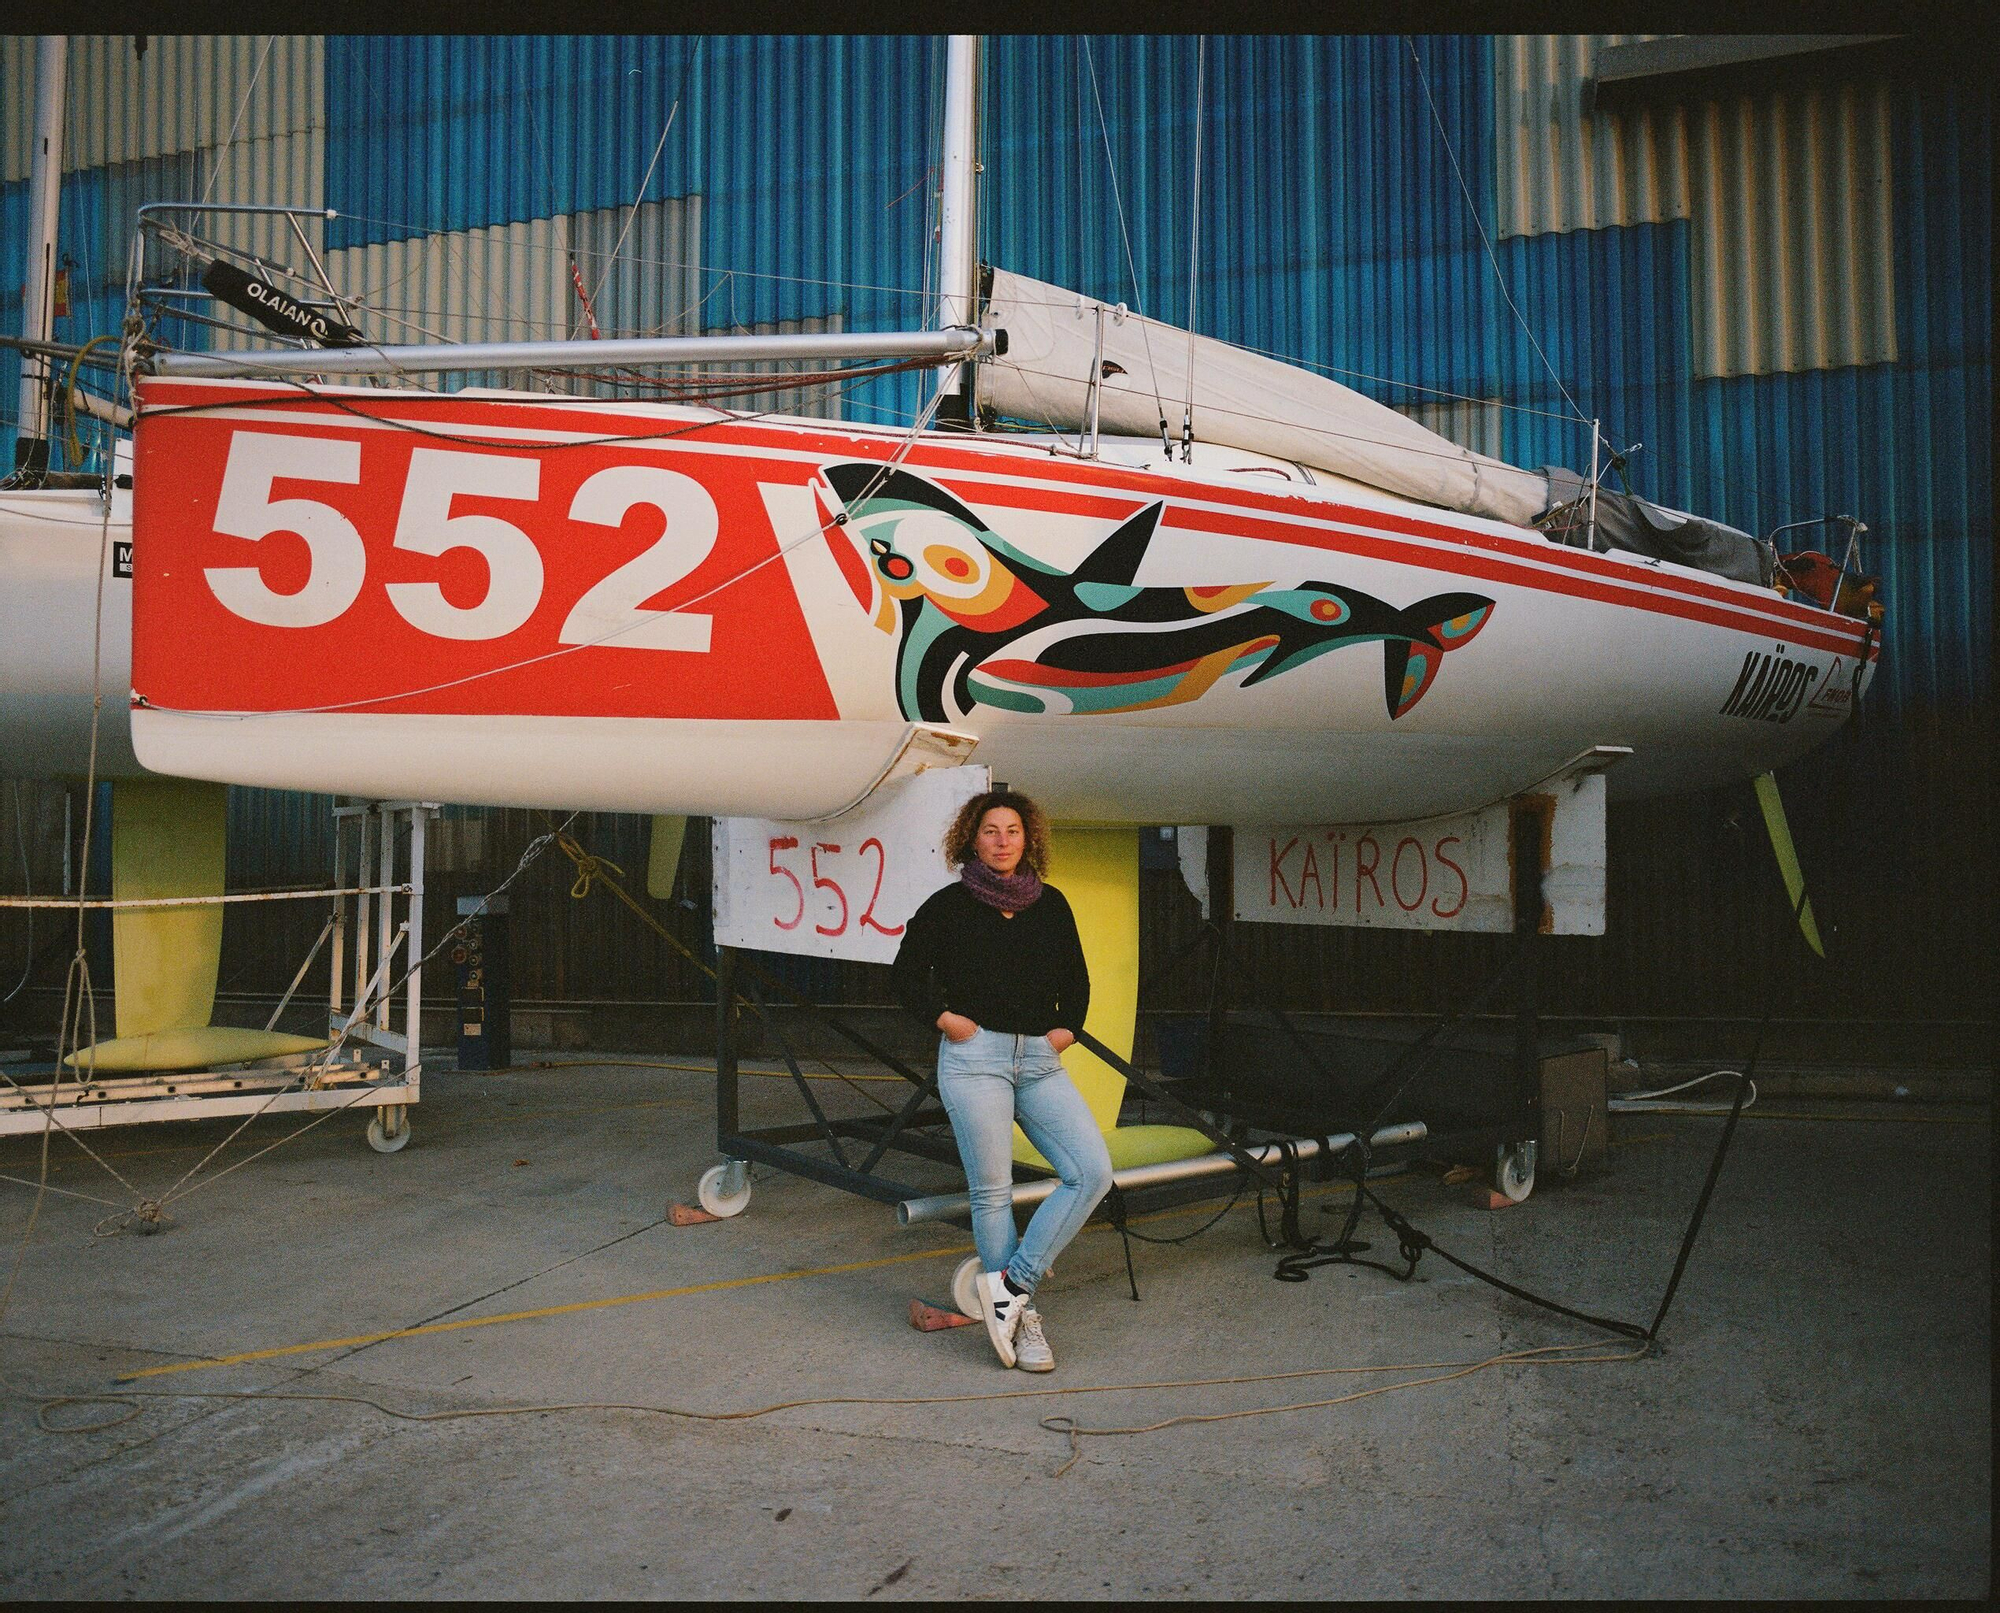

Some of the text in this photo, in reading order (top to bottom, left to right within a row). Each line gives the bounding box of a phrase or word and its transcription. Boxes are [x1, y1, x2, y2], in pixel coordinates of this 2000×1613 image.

[203, 430, 719, 653] 552
[1719, 643, 1819, 724] KAÏROS
[770, 837, 905, 936] 552
[1270, 829, 1468, 918] KAÏROS
